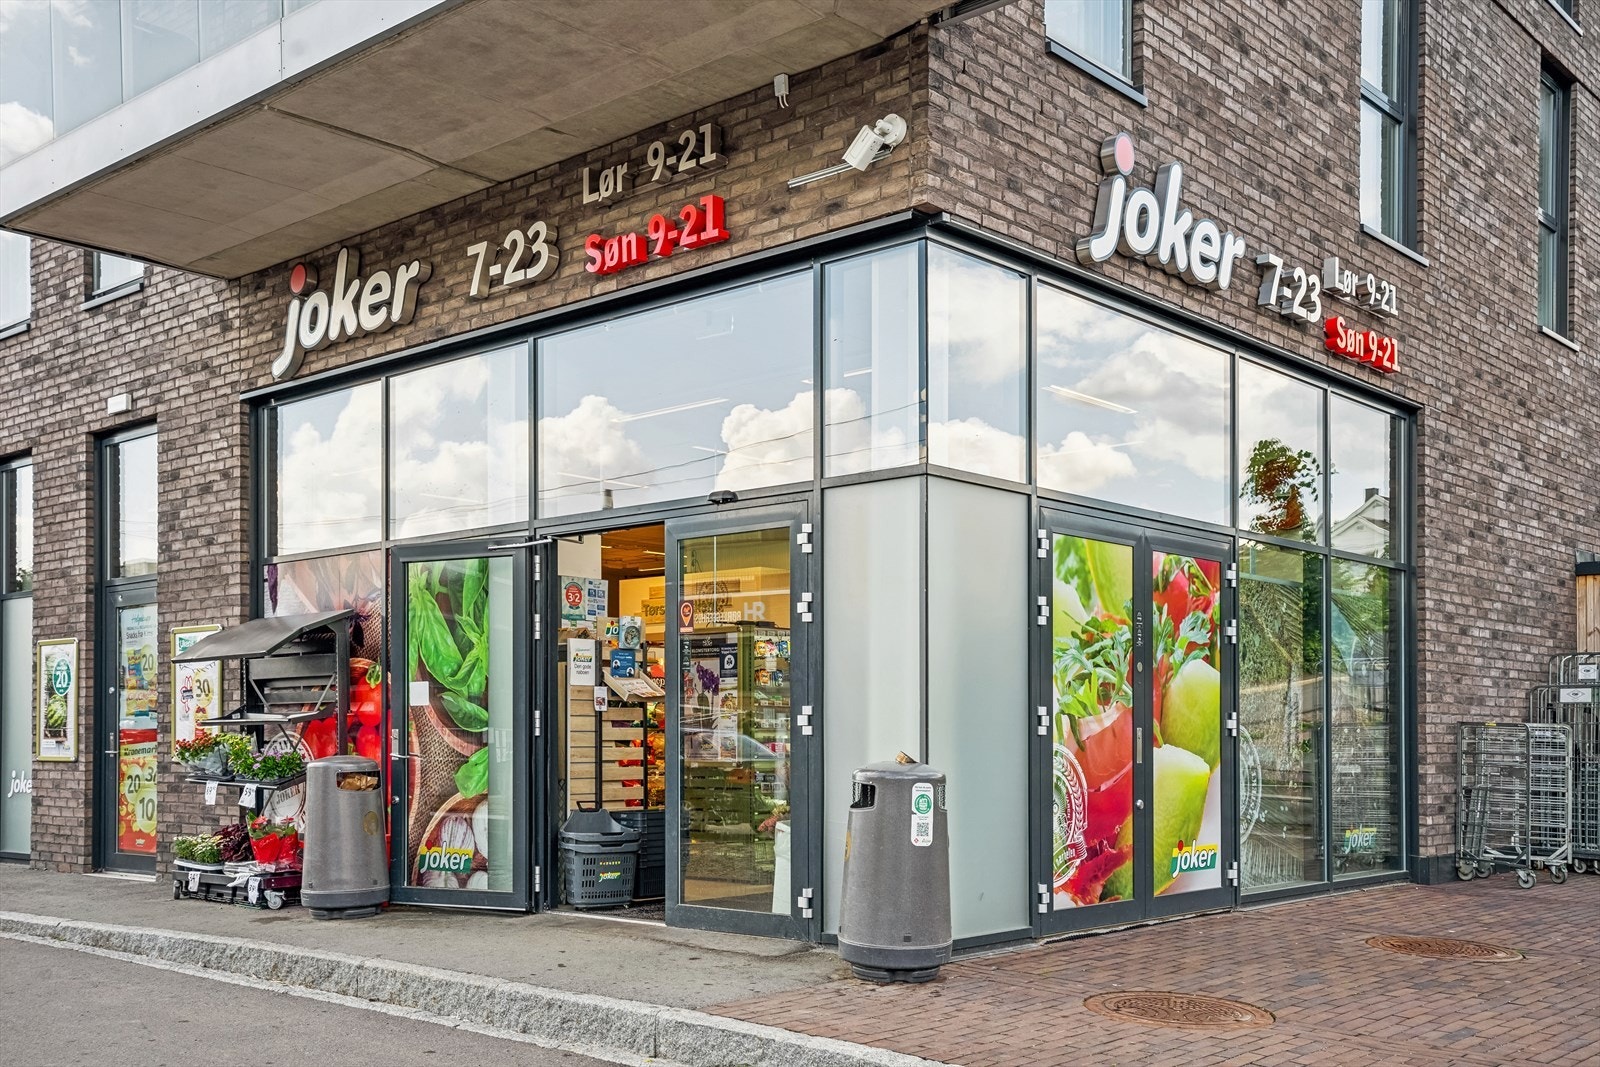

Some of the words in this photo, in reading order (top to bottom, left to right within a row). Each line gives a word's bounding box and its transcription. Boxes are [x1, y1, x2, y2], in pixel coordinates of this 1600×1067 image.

[583, 160, 629, 205] Lør
[646, 123, 718, 182] 9-21
[1088, 131, 1246, 291] joker
[467, 220, 555, 297] 7-23
[585, 232, 640, 275] Søn
[648, 195, 722, 256] 9-21
[1257, 254, 1322, 323] 7-23
[1331, 257, 1359, 297] Lør
[1366, 273, 1399, 317] 9-21
[271, 246, 426, 380] joker
[1335, 316, 1365, 354] Søn
[1368, 333, 1401, 371] 9-21
[55, 671, 69, 688] 20
[142, 653, 154, 672] 20
[195, 678, 211, 697] 30
[126, 774, 141, 794] 20
[139, 797, 155, 822] 10
[420, 840, 469, 873] joker
[1172, 839, 1215, 879] joker
[1345, 825, 1375, 854] joker
